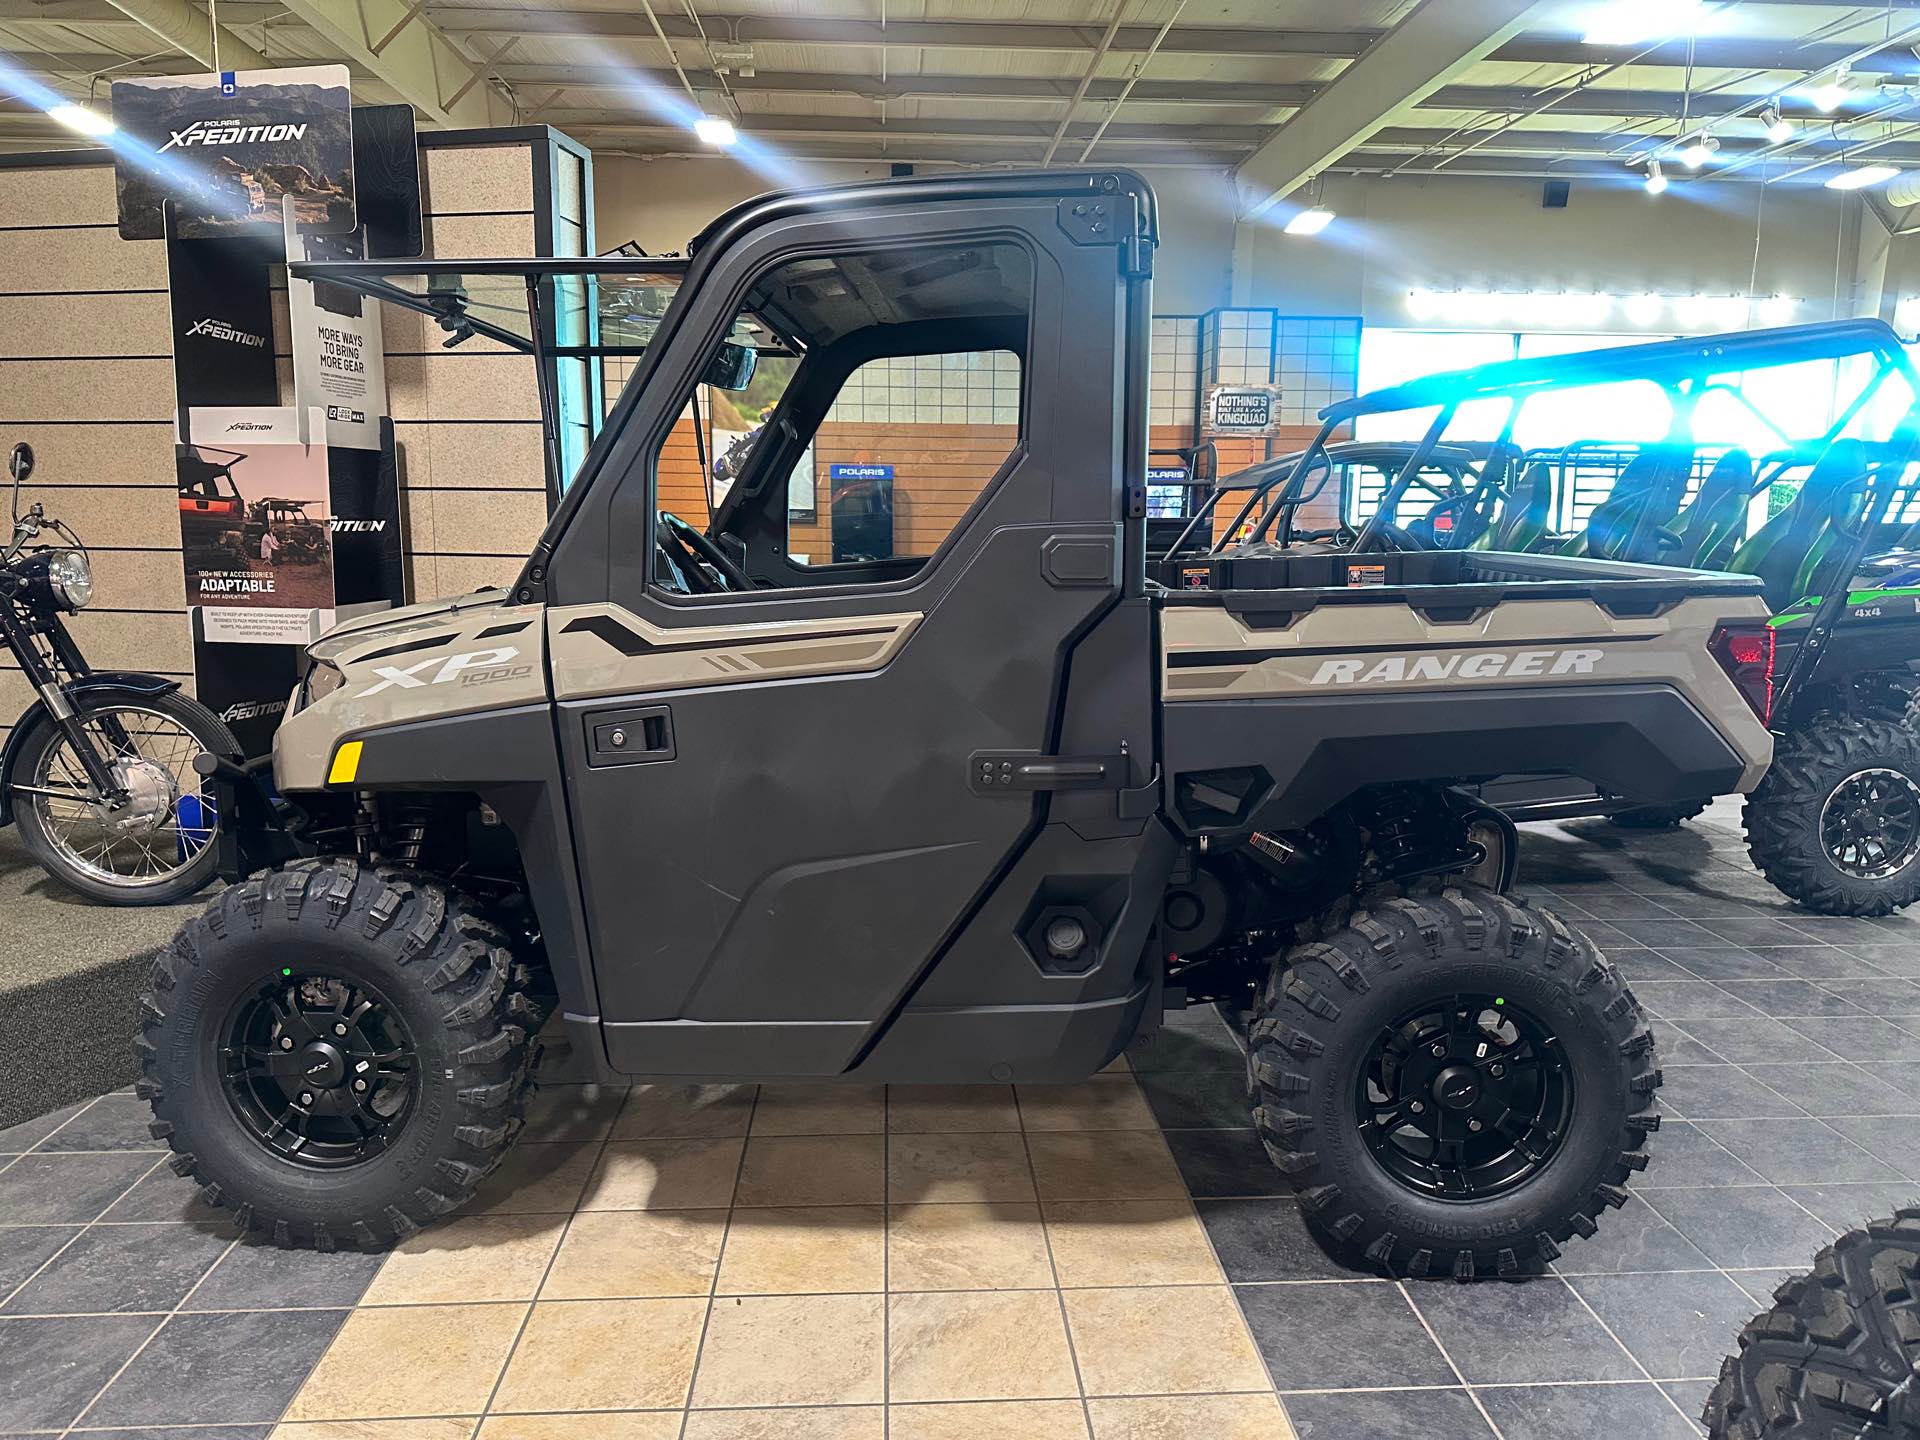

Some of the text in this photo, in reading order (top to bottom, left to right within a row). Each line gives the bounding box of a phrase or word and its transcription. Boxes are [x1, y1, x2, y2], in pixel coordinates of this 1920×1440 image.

[204, 119, 241, 127] POLARIS
[155, 121, 308, 154] XPEDITION
[184, 318, 265, 348] XPEDITION
[318, 326, 363, 347] MORE WAYS
[323, 341, 359, 359] TO BRING
[320, 354, 364, 373] MORE GEAR
[1218, 395, 1268, 407] NOTHING'S
[1217, 412, 1266, 424] KINGQUAD
[225, 422, 273, 432] XPEDITION
[839, 468, 885, 476] POLARIS
[330, 520, 386, 532] DITION
[229, 571, 274, 579] ACCESSORIES
[200, 579, 276, 593] ADAPTABLE
[1854, 607, 1882, 618] 4x4
[352, 647, 532, 699] XP 1000
[1310, 650, 1604, 684] RANGER
[219, 701, 288, 722] XPEDITION
